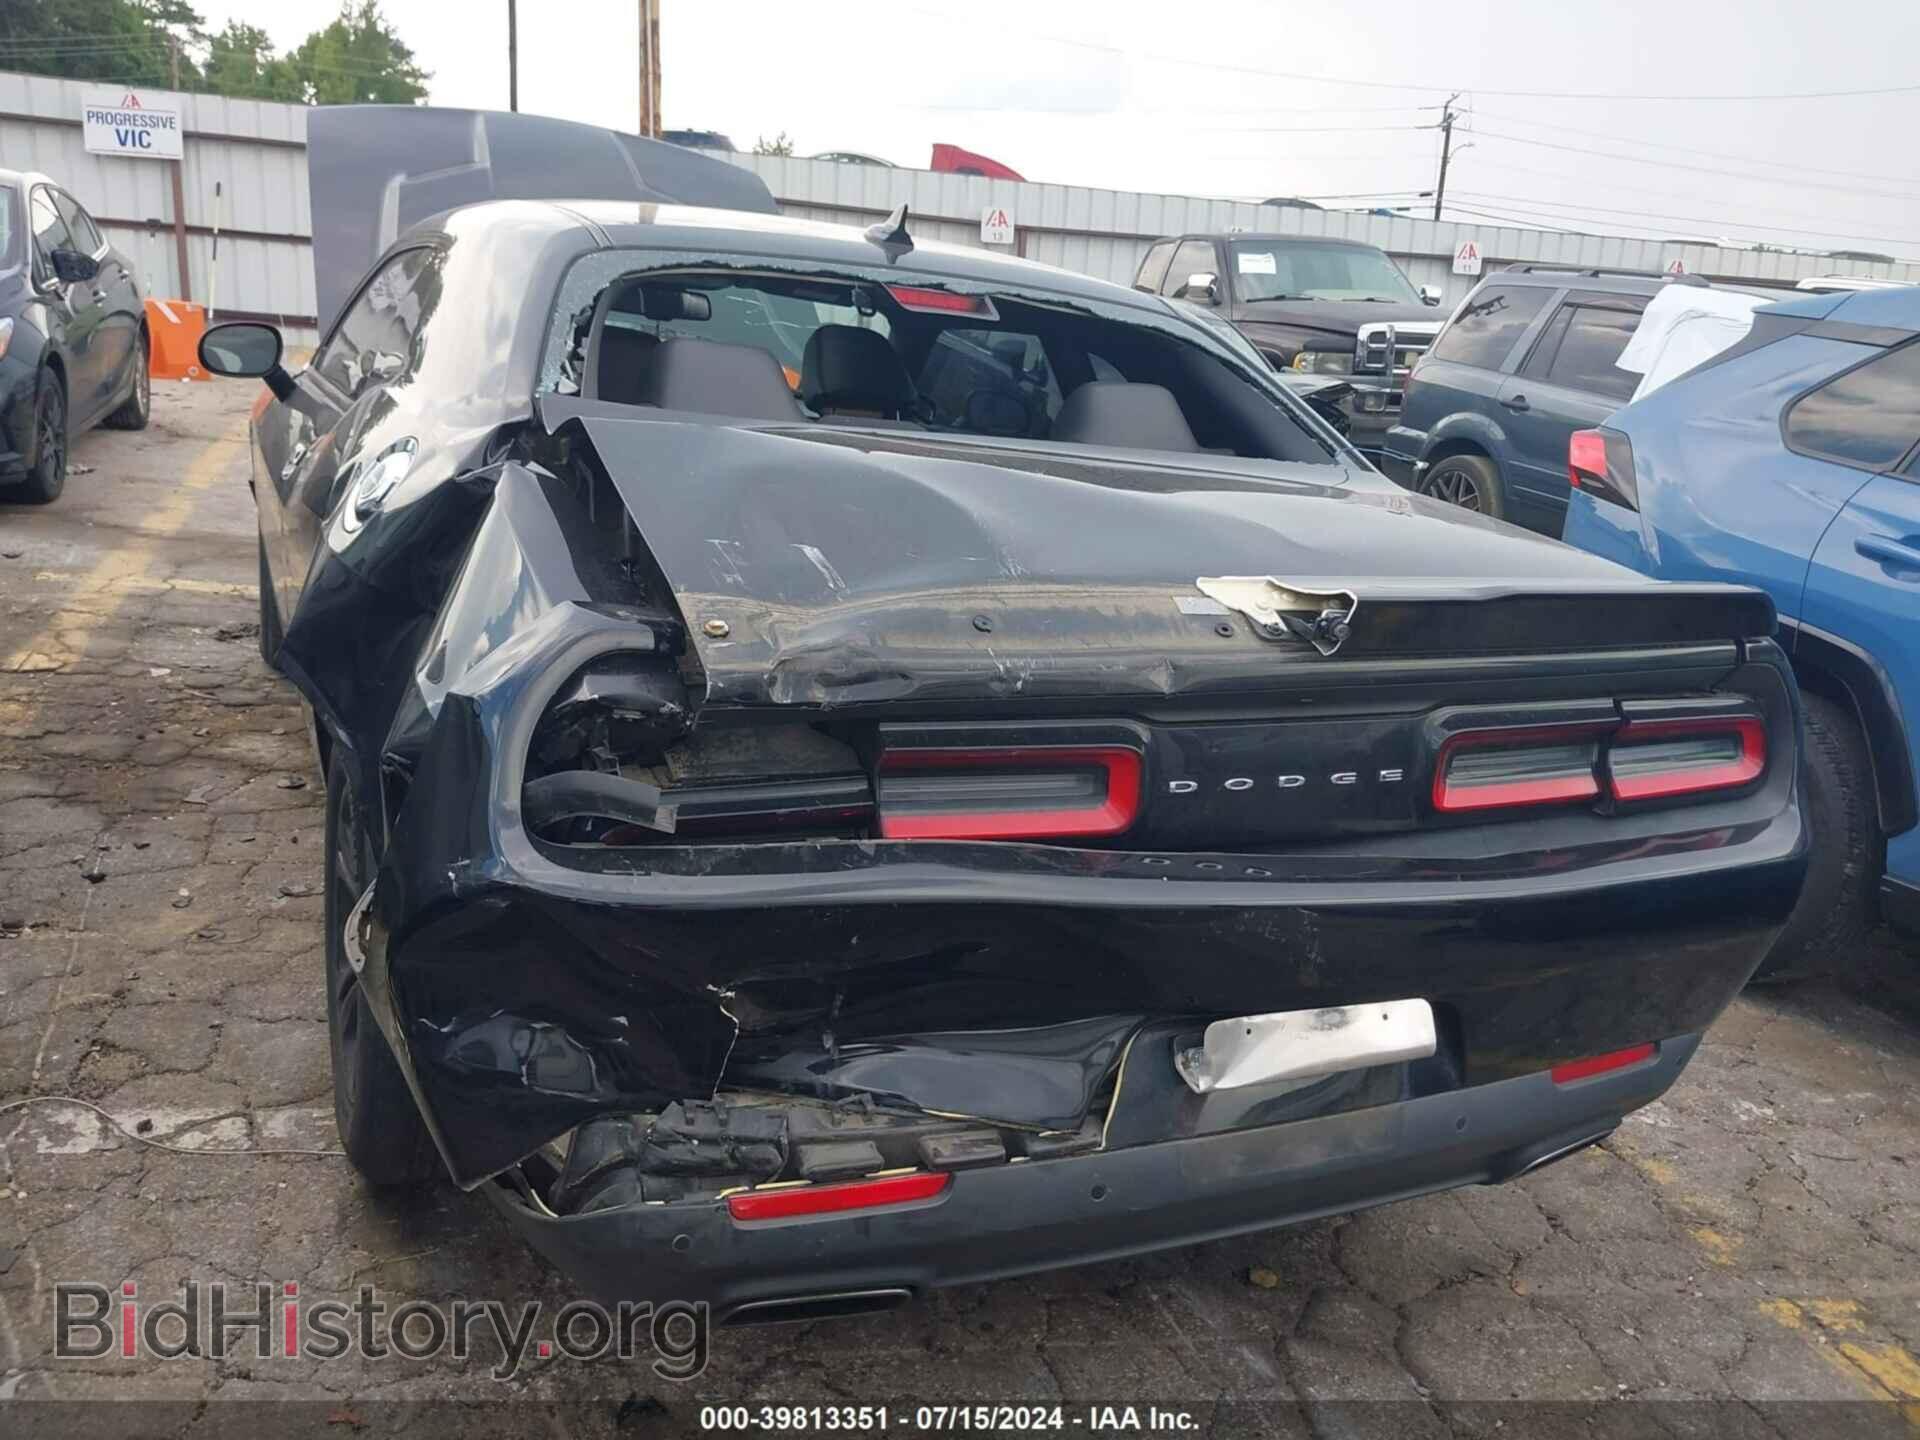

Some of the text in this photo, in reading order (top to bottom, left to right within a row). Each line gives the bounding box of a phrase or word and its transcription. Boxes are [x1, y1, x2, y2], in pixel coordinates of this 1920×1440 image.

[87, 110, 176, 130] PROGRESSIVE
[115, 128, 152, 149] VIC
[1169, 769, 1403, 793] DODGE
